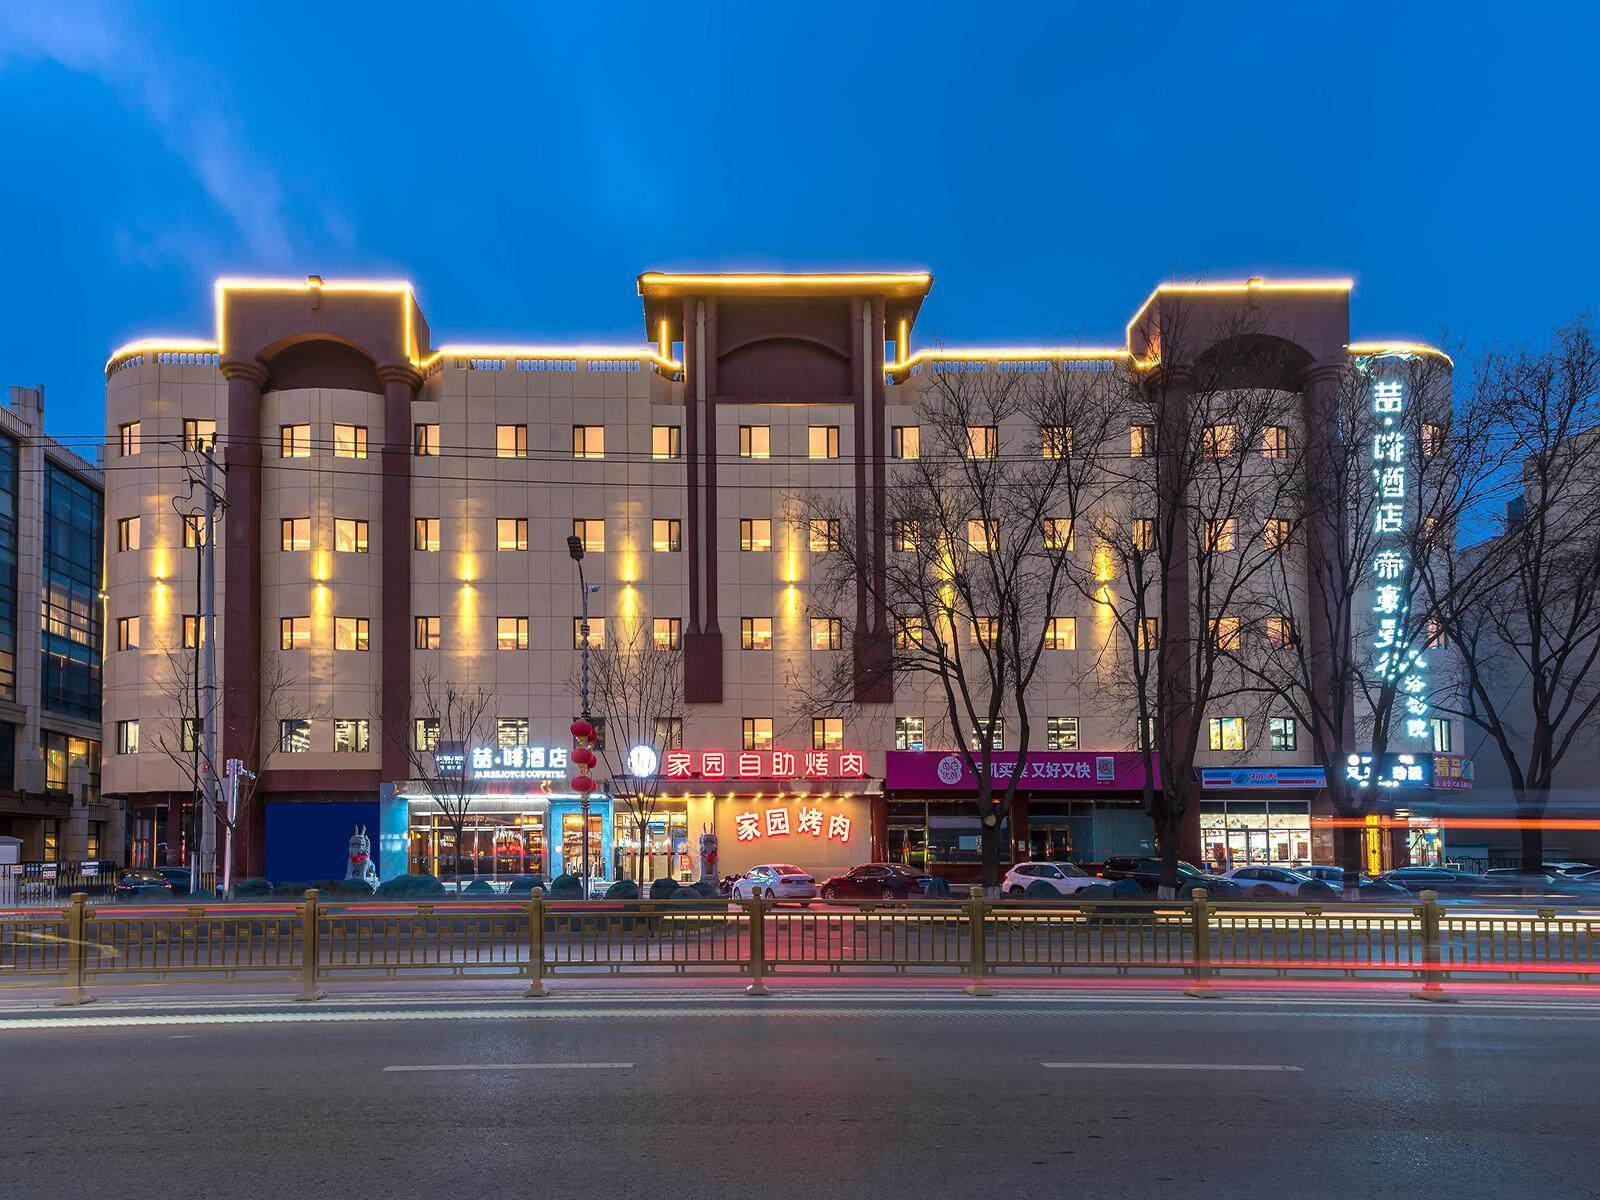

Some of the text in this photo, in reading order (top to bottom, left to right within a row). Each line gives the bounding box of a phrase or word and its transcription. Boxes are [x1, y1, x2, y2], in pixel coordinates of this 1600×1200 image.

[473, 748, 567, 768] 喆·啡酒店
[667, 752, 863, 776] 家园自助烤肉
[1032, 762, 1090, 779] 又好又快
[735, 807, 850, 842] 家园烤肉
